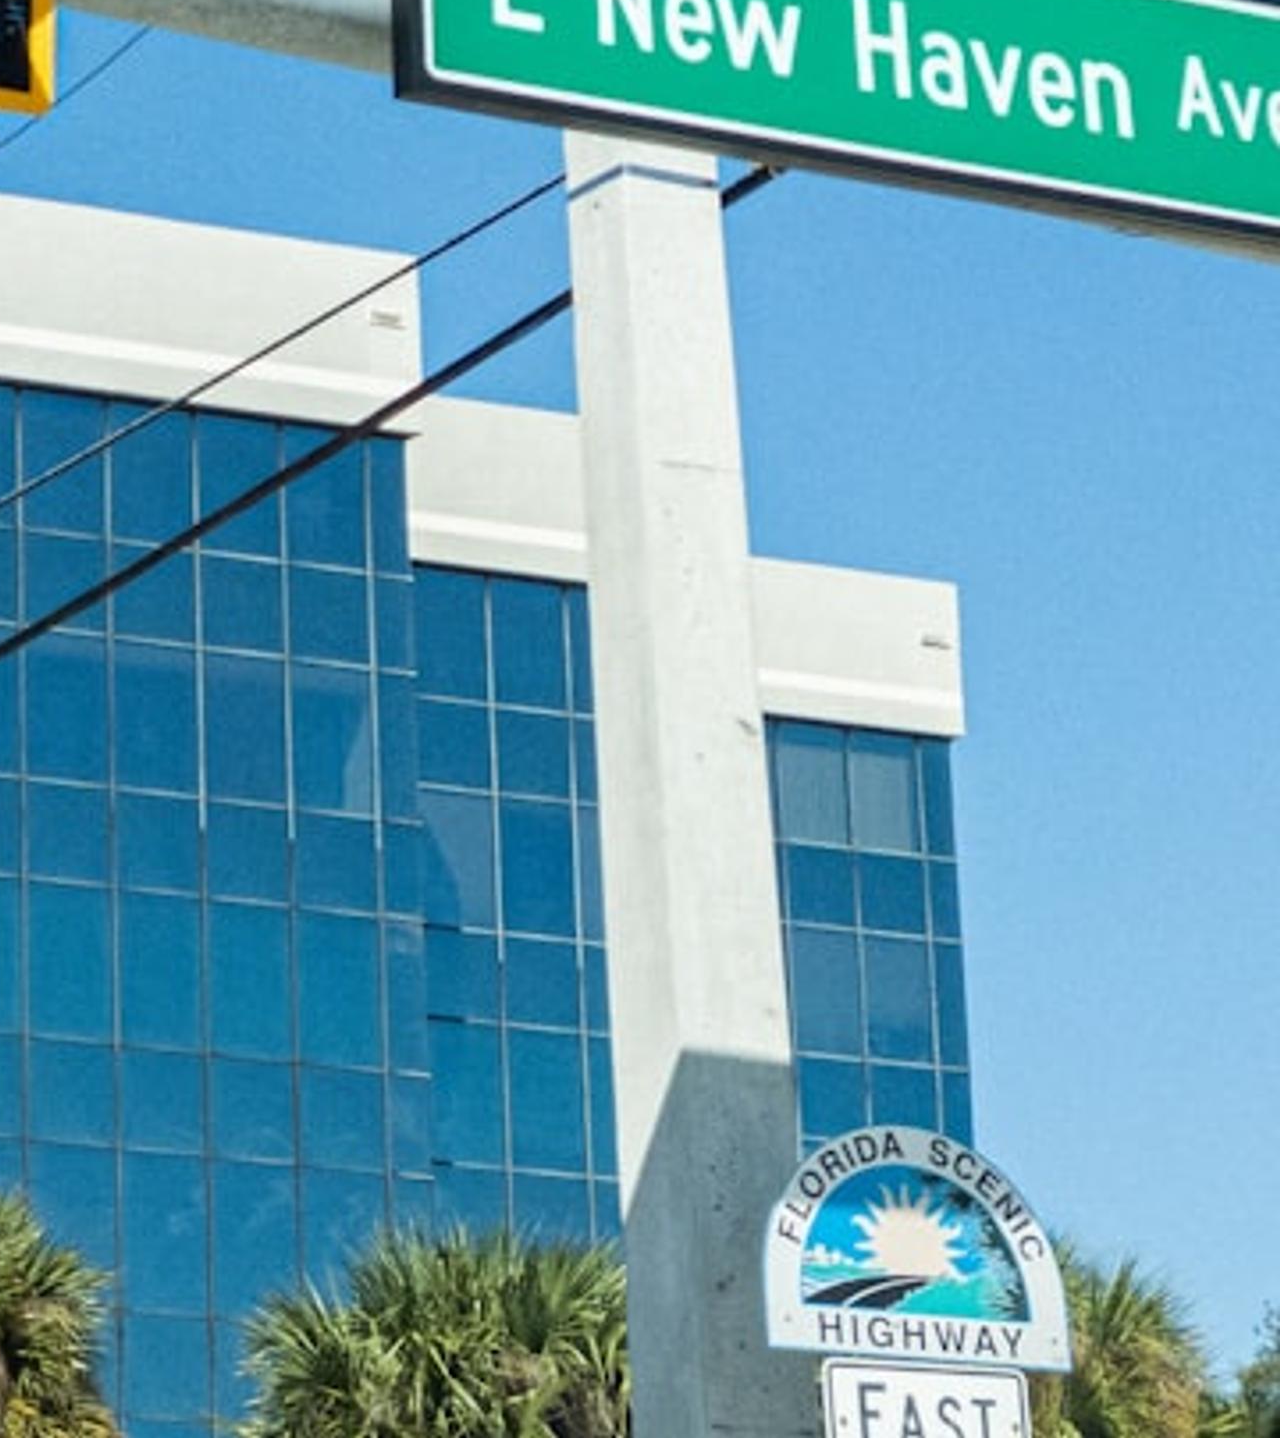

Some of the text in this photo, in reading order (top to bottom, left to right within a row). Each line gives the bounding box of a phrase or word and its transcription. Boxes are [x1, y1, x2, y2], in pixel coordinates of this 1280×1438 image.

[778, 1132, 1044, 1262] FLORIDA SCENIC
[818, 1312, 1023, 1358] HIGHWAY
